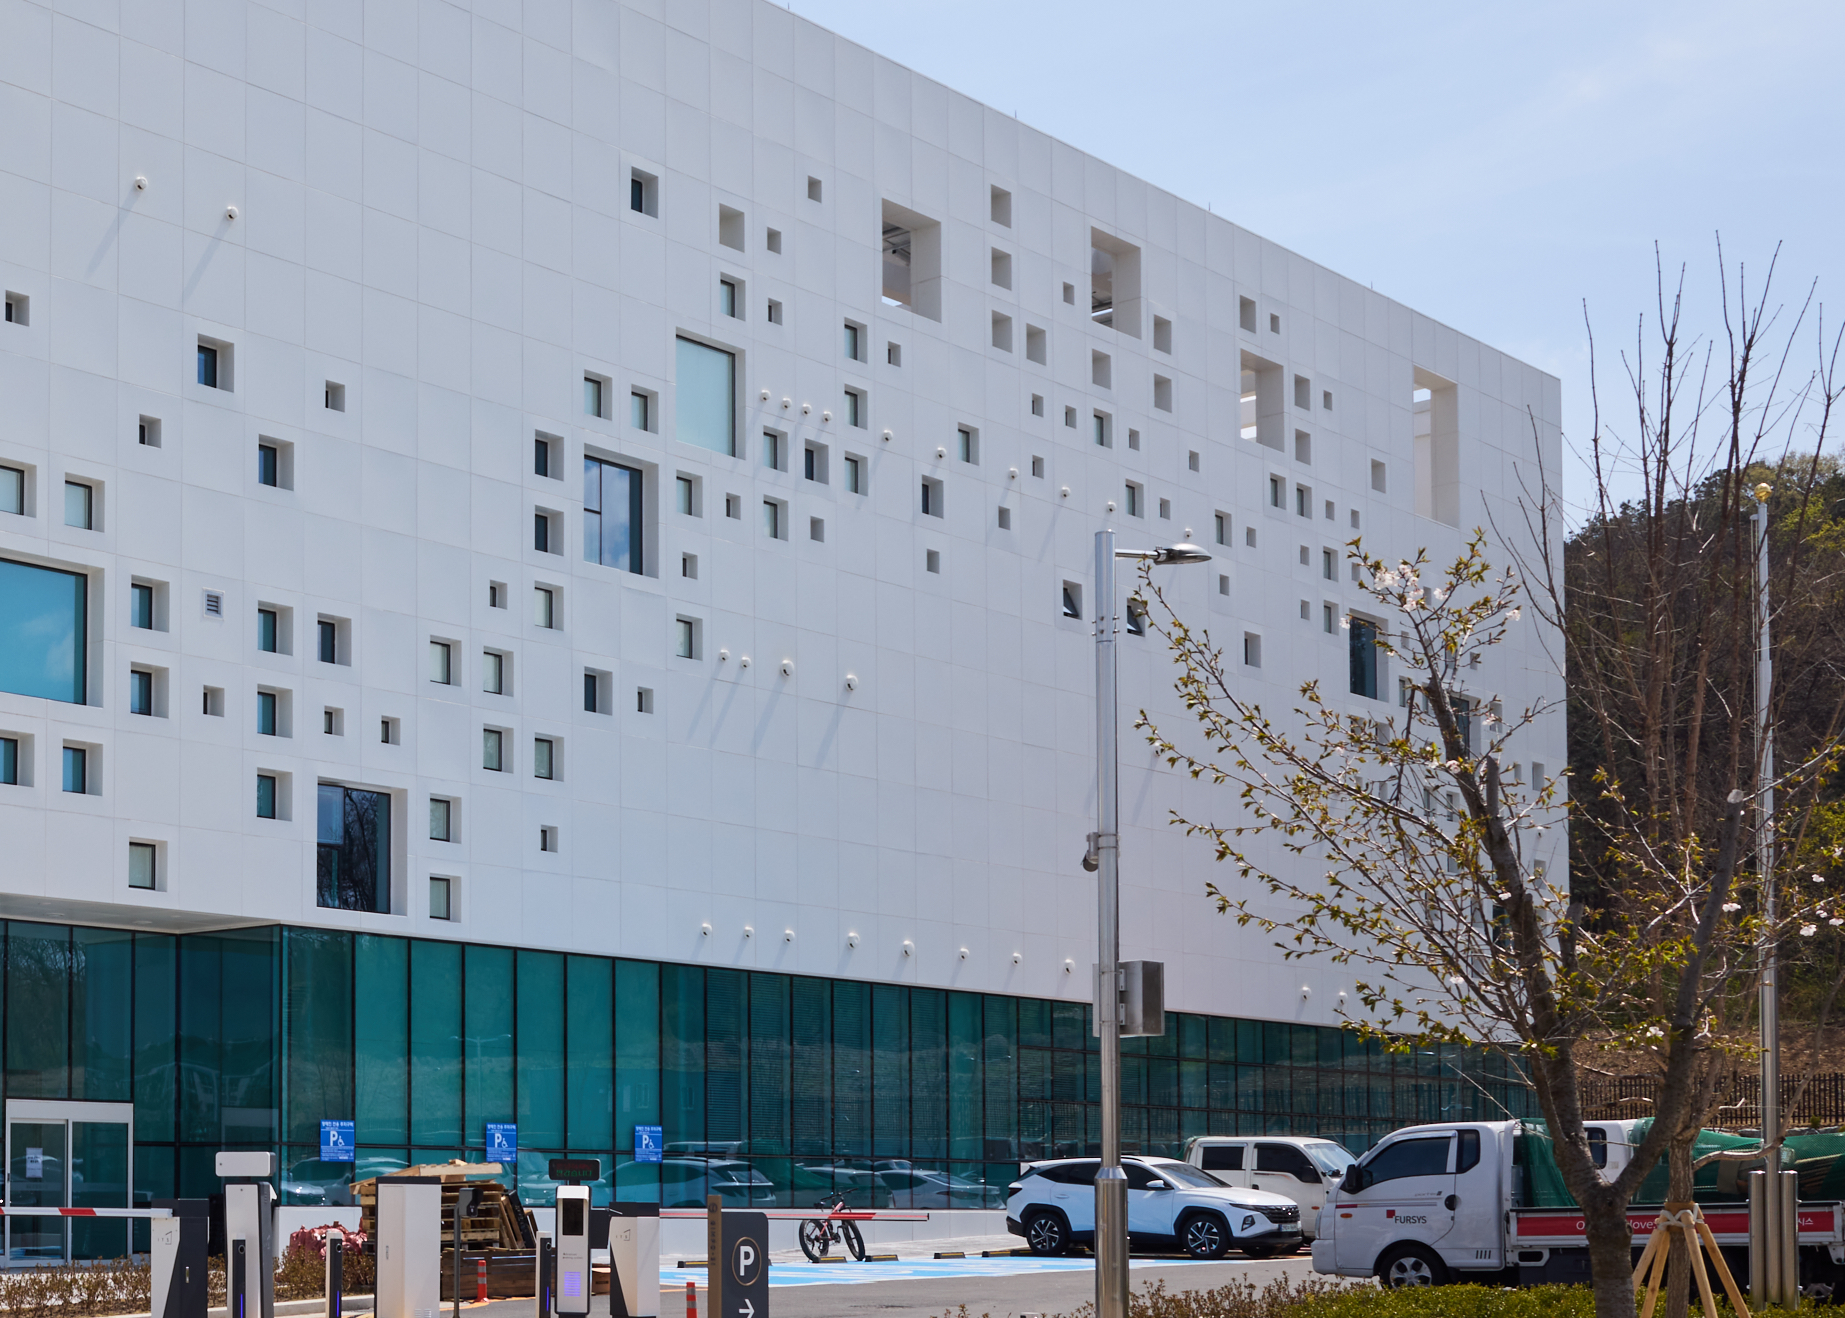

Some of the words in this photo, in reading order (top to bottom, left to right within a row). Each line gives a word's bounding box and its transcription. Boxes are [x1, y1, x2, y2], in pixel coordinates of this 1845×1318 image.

[330, 1131, 338, 1146] P
[495, 1133, 502, 1148] P
[643, 1135, 649, 1149] P
[1394, 1215, 1427, 1224] FURSYS
[739, 1245, 755, 1277] P
